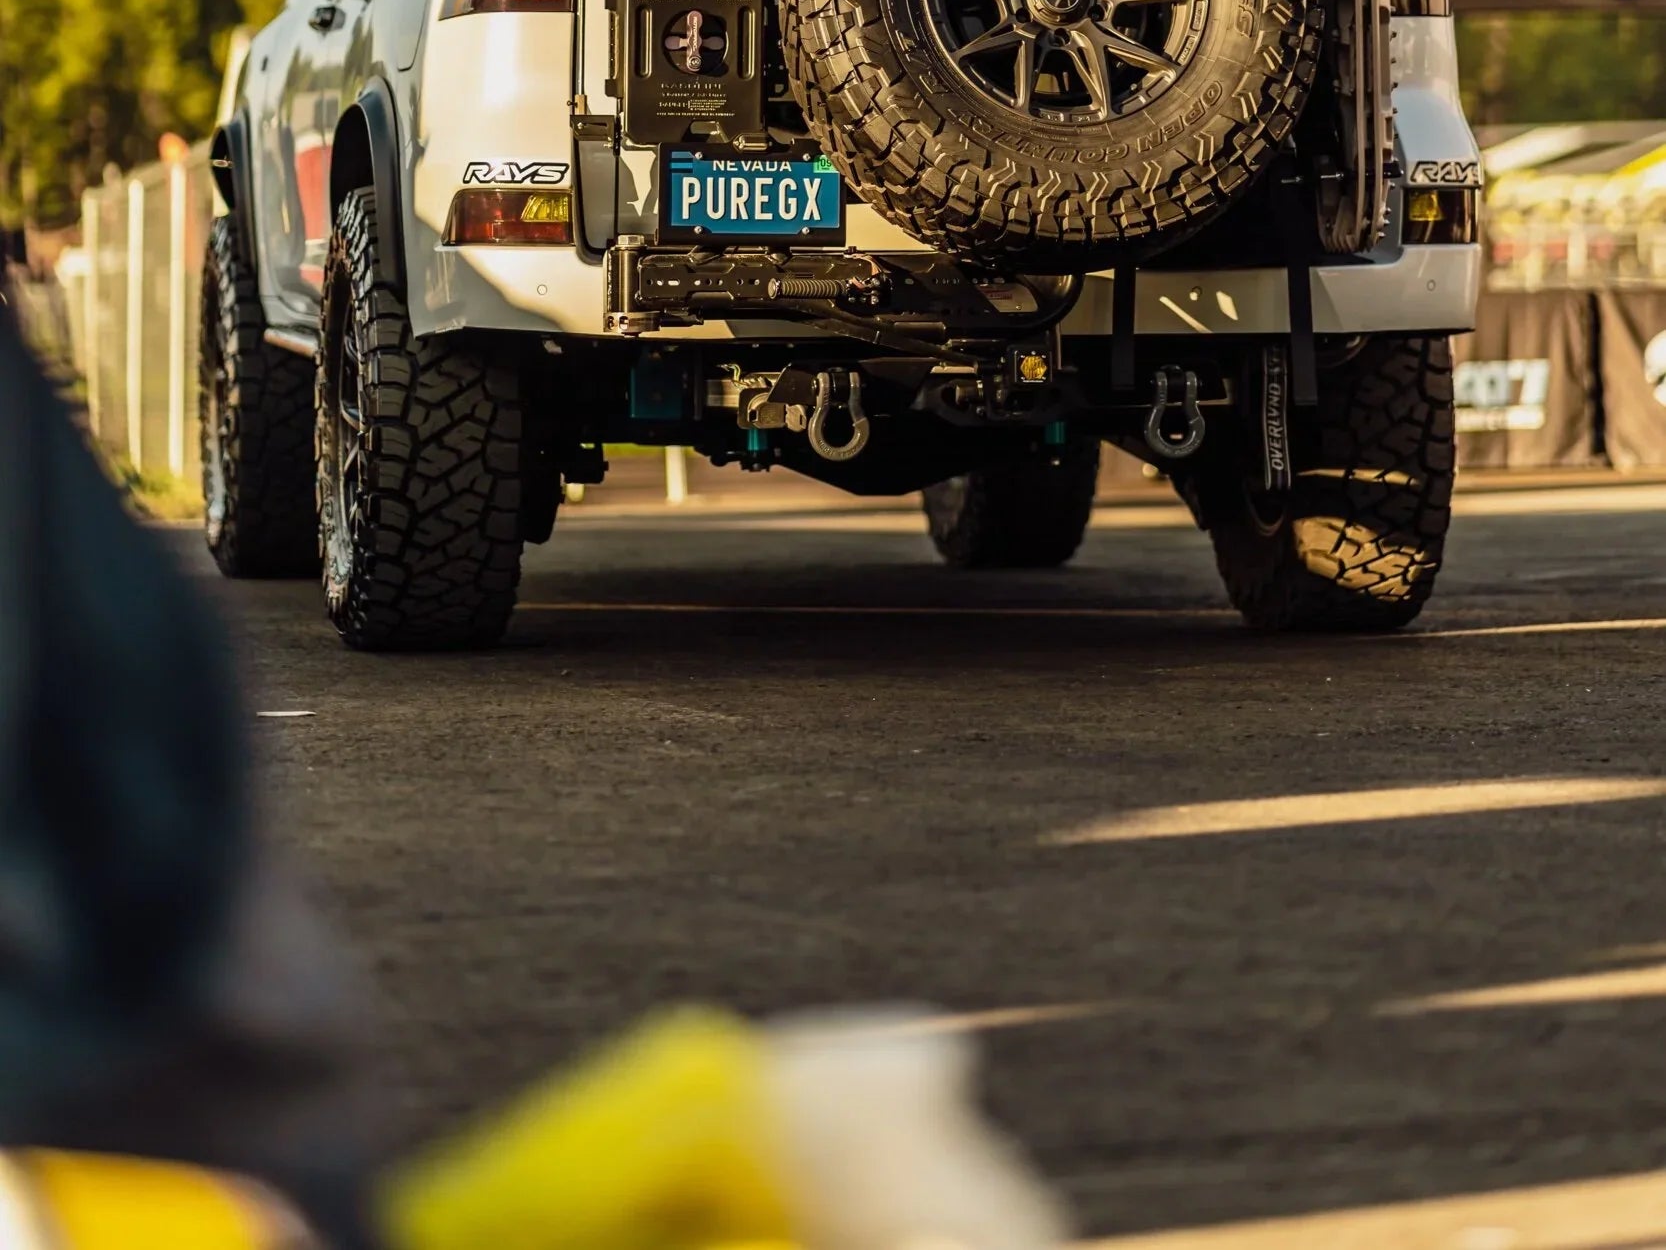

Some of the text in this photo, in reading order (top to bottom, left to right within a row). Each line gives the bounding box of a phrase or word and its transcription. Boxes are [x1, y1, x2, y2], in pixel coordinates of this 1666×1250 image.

[1137, 79, 1223, 153] OPEN
[462, 161, 570, 184] RAYS
[713, 160, 792, 172] NEVADA
[682, 176, 821, 221] PUREGX
